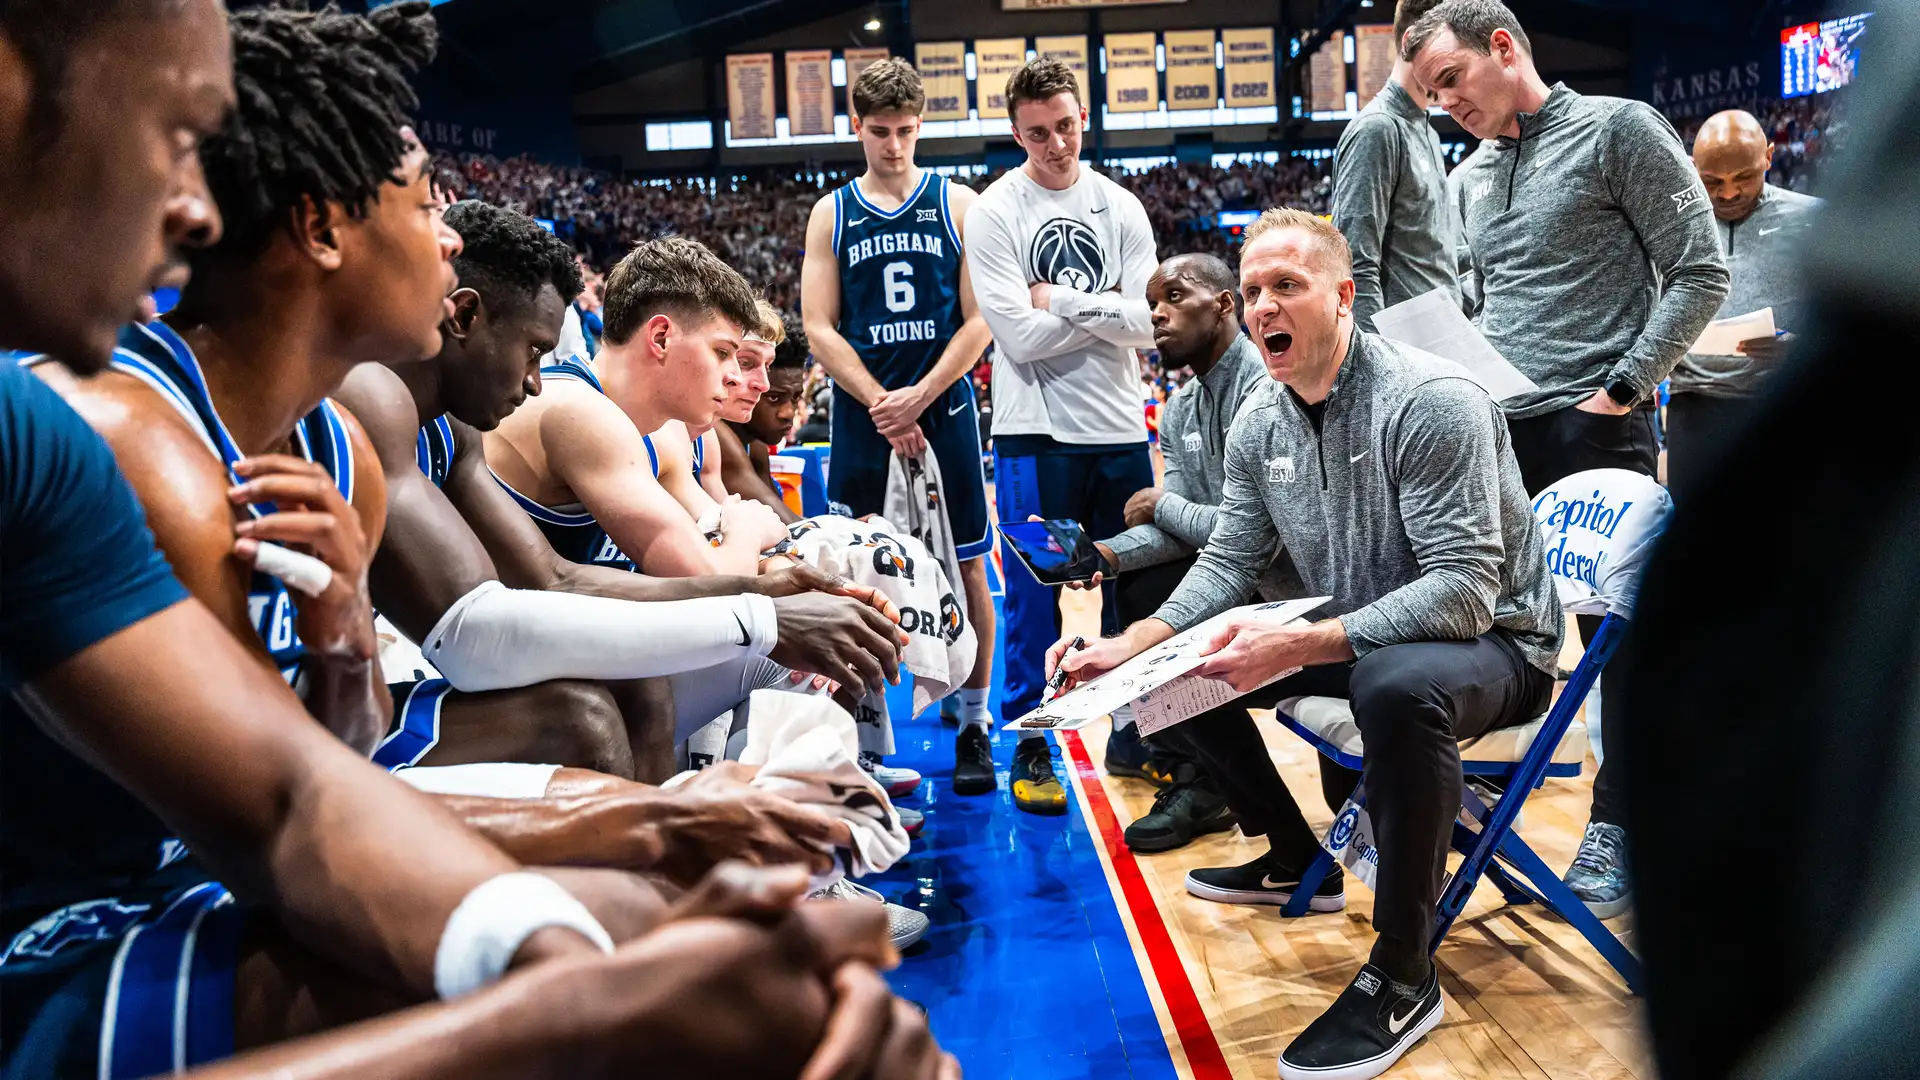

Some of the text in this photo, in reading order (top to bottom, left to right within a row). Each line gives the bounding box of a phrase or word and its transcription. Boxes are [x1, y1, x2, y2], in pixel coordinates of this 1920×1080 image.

[1112, 47, 1149, 56] NATIONAL
[1172, 44, 1209, 54] NATIONAL
[1229, 42, 1267, 51] NATIONAL
[1108, 60, 1155, 69] CHAMPIONS
[1166, 58, 1216, 67] CHAMPIONS
[1224, 54, 1273, 64] CHAMPIONS
[1231, 82, 1269, 98] 2022
[1652, 61, 1761, 106] KANSAS
[1117, 87, 1149, 103] 1988
[1174, 85, 1210, 101] 2008
[847, 232, 943, 267] BRIGHAM
[883, 261, 916, 313] 6
[1062, 269, 1083, 290] Y
[868, 319, 936, 345] YOUNG
[1270, 467, 1295, 482] BYU
[1533, 489, 1633, 539] Capitol
[1547, 537, 1603, 589] deral
